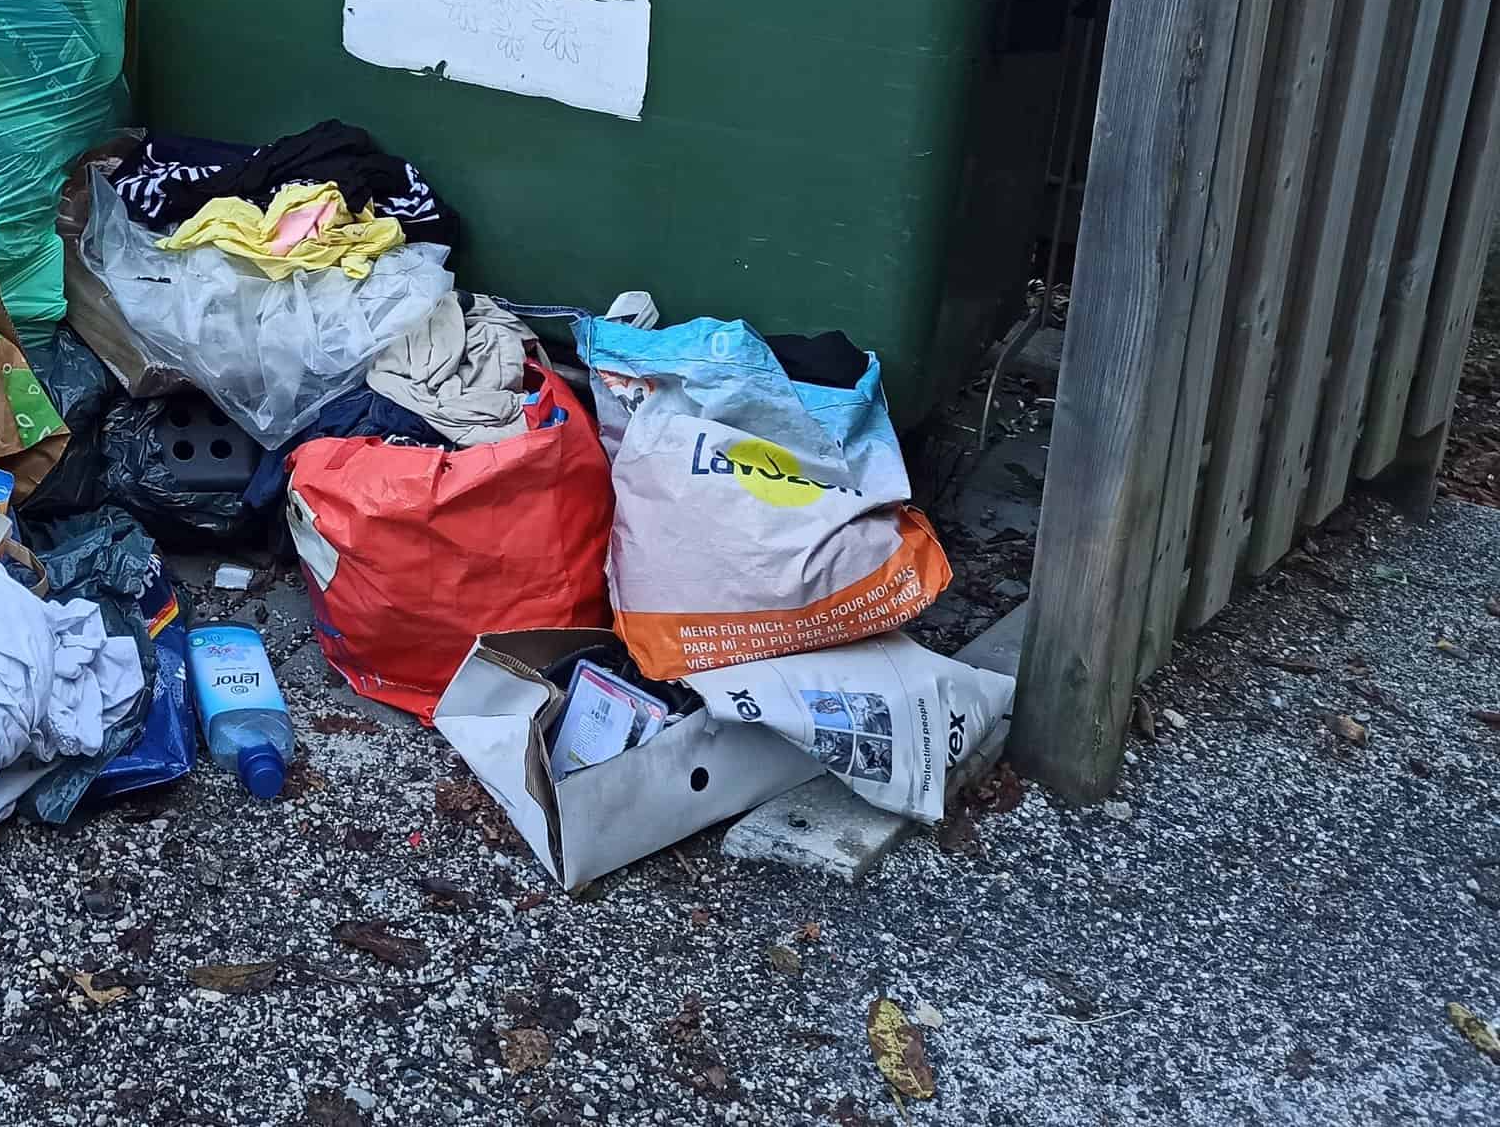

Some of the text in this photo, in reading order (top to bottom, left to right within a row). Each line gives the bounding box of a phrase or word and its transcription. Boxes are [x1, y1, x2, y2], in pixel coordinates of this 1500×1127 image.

[680, 625, 718, 639] MEHR
[720, 621, 747, 636] FÜR
[749, 621, 785, 635] MICH
[795, 612, 829, 630] PLUS
[831, 596, 866, 619] POUR
[866, 585, 889, 603] MOI
[683, 641, 718, 654] PARA
[750, 637, 765, 649] DI
[797, 628, 822, 641] PER
[827, 621, 846, 634] ME
[858, 603, 890, 624] MENI
[686, 654, 715, 670] VIŠE
[881, 609, 912, 628] NUDI
[212, 672, 260, 687] Lenor
[917, 698, 932, 792] Protecting people
